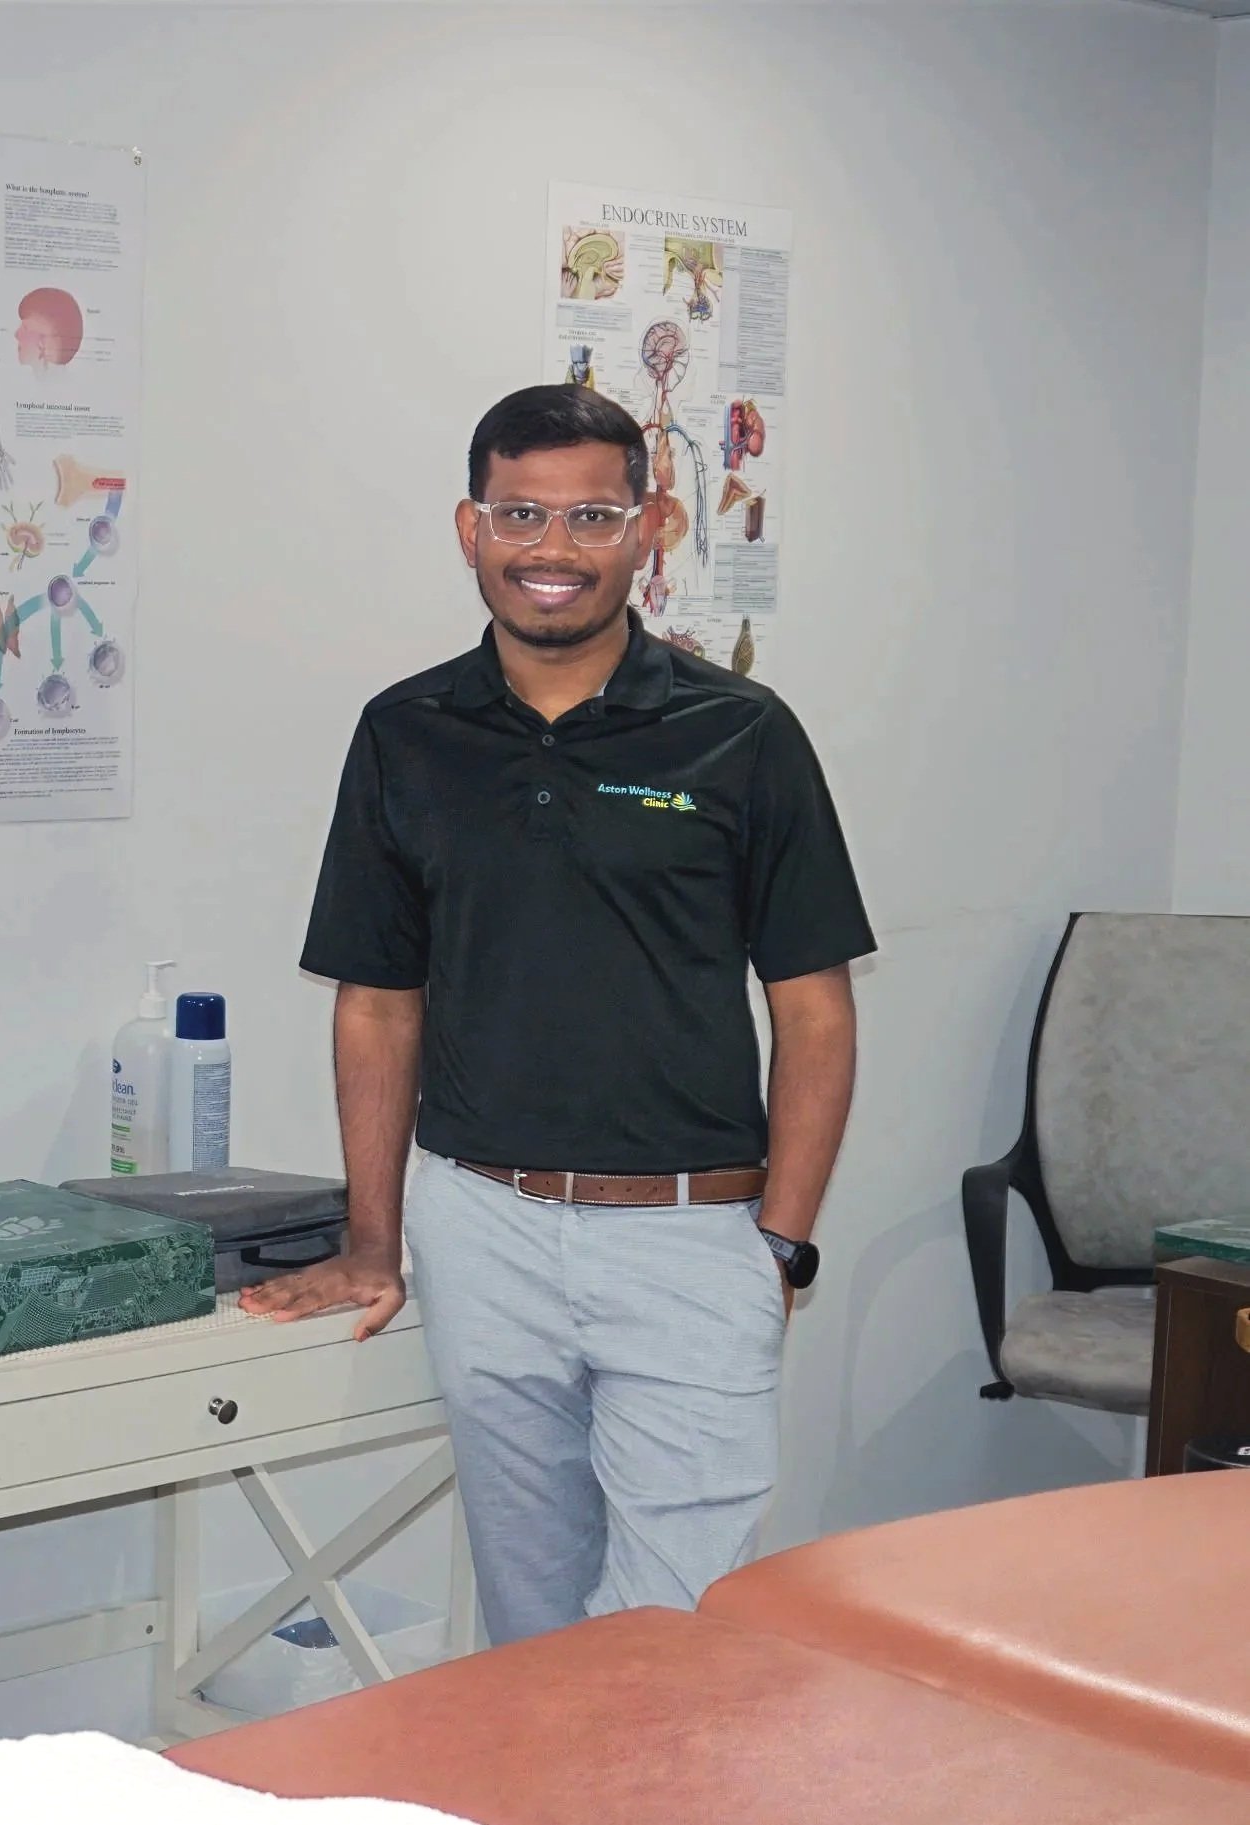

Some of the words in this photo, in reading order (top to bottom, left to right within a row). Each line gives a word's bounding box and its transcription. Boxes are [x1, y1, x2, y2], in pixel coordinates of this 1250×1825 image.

[602, 204, 689, 230] ENDOCRINE
[693, 215, 747, 236] SYSTEM
[598, 784, 627, 794] Aston
[629, 786, 672, 799] Wellness
[643, 798, 669, 808] Clinic
